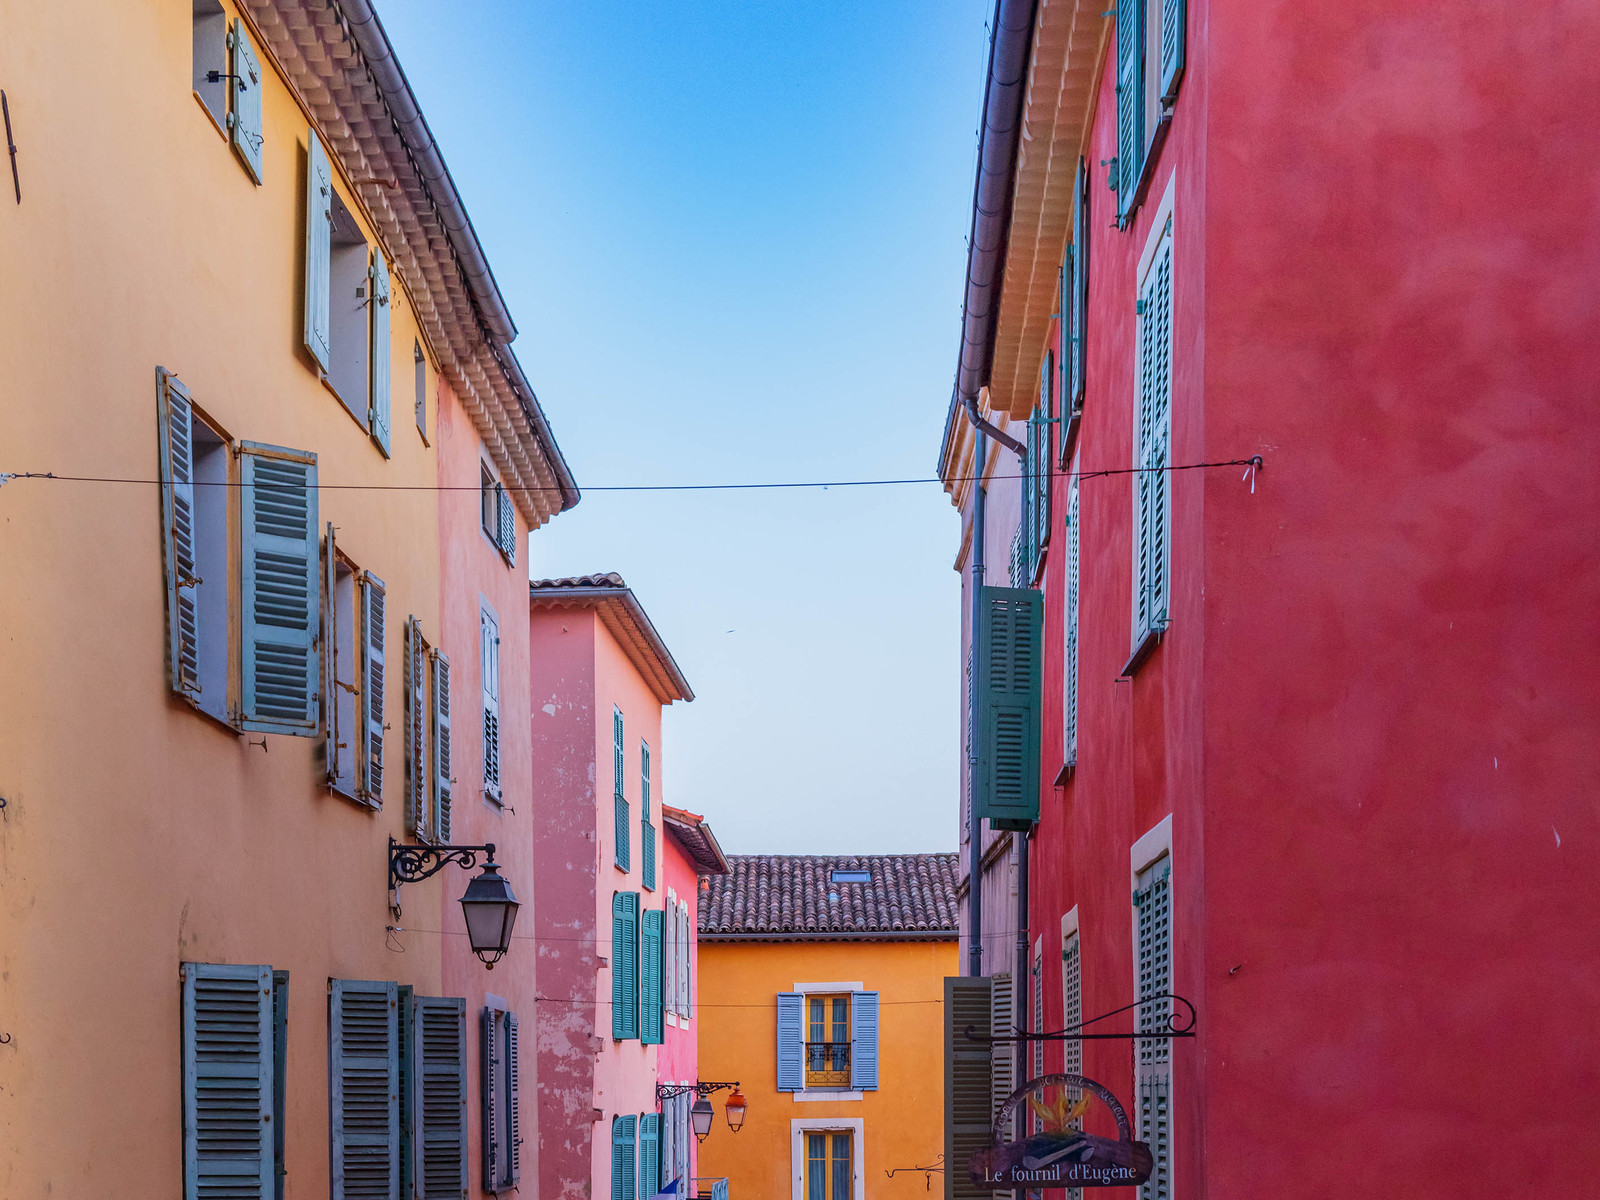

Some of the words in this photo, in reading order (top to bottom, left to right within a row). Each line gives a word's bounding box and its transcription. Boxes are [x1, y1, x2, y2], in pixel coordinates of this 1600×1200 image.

[984, 1167, 1003, 1182] Le
[1011, 1165, 1060, 1182] fournil
[1069, 1163, 1137, 1184] d'Eugène
